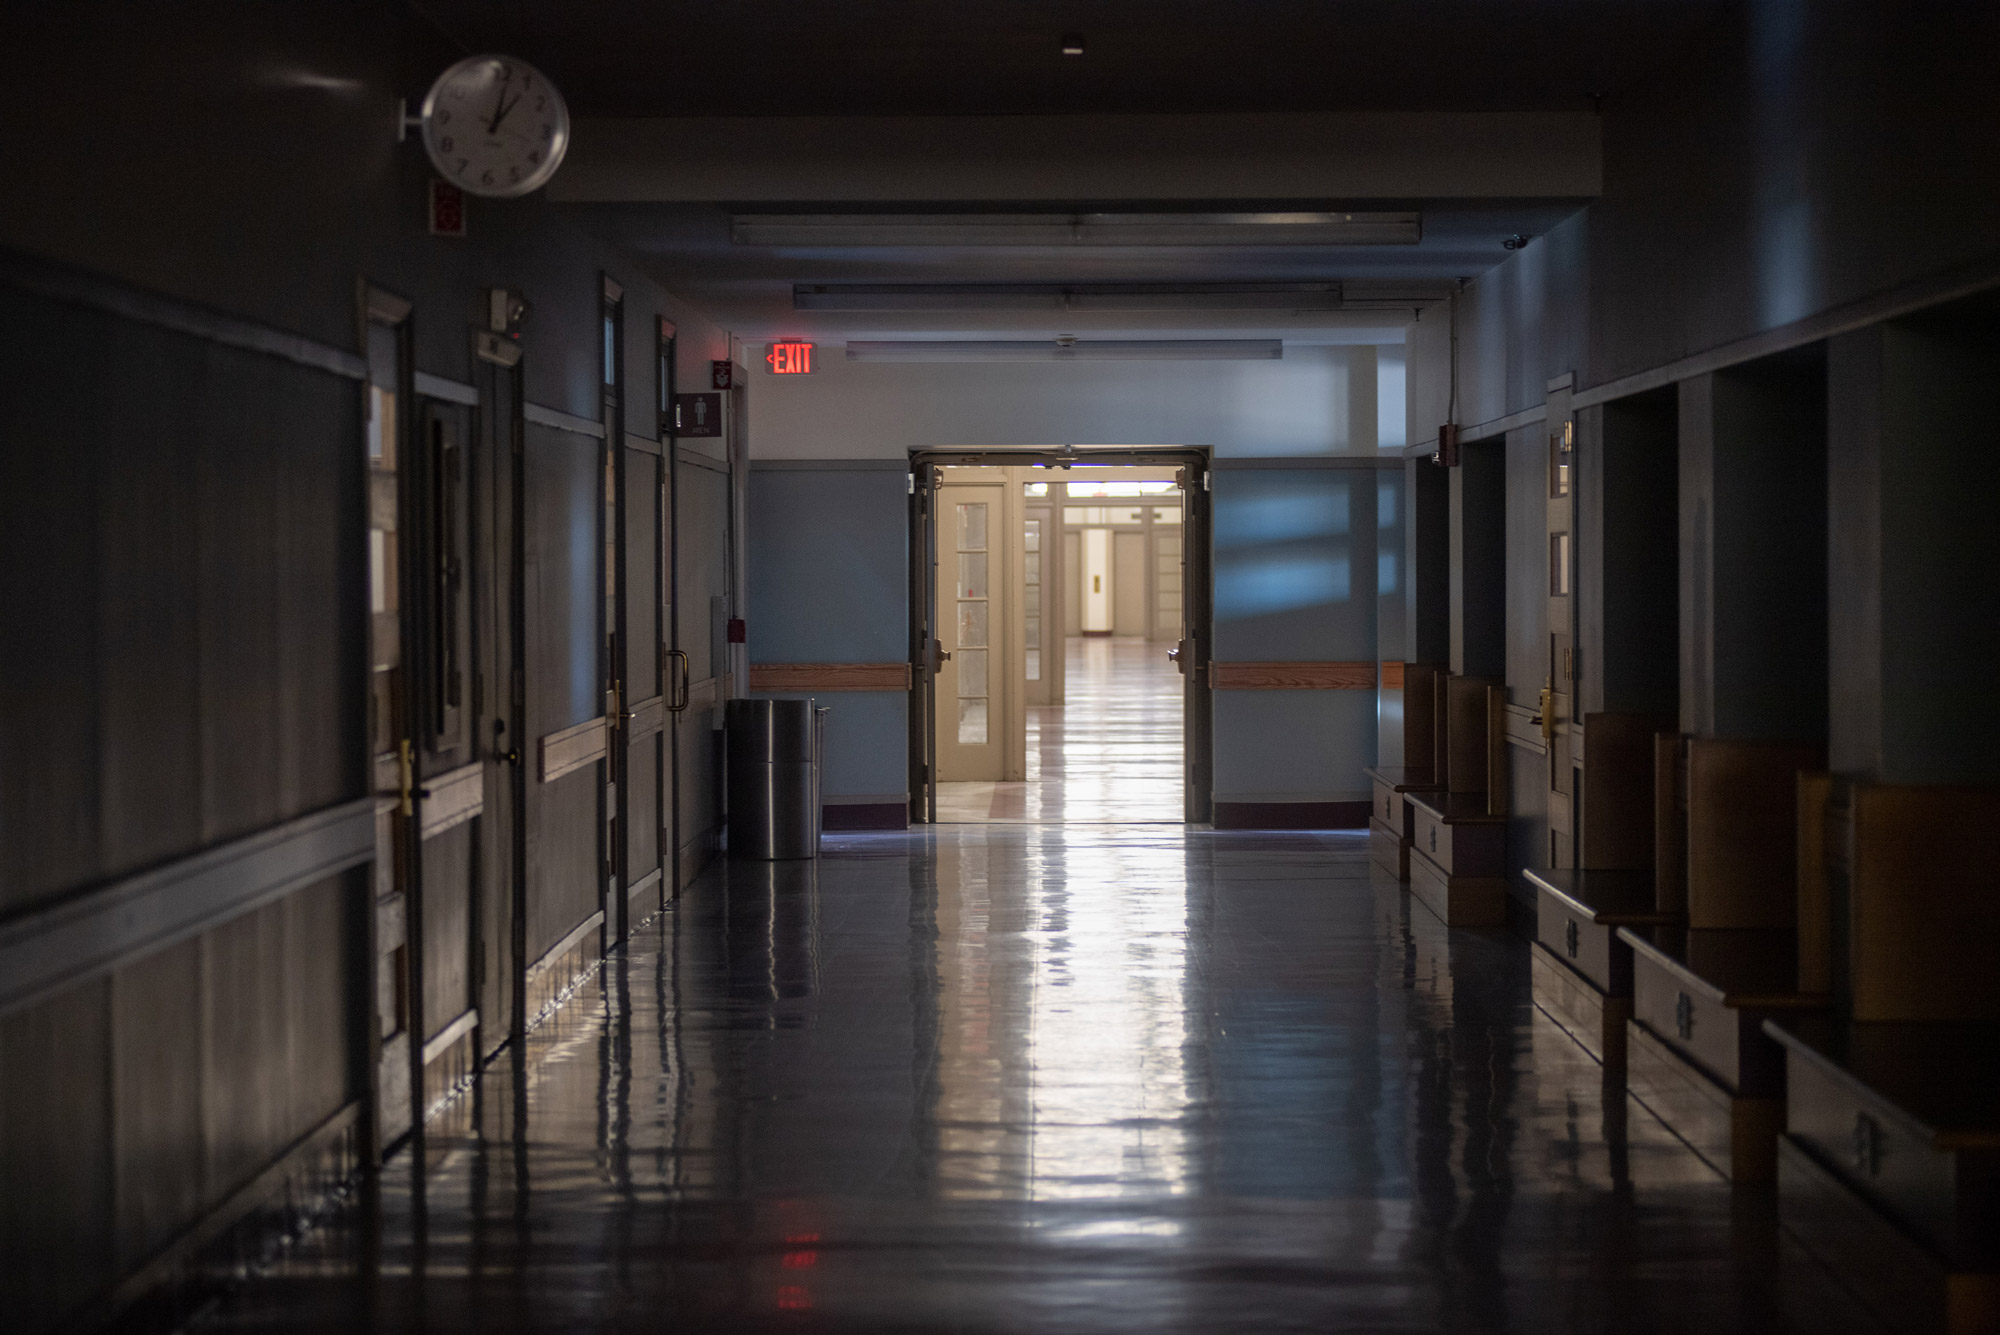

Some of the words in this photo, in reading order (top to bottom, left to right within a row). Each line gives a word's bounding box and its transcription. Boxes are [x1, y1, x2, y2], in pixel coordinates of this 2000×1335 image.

[522, 74, 531, 91] 1
[535, 95, 546, 112] 2
[439, 109, 451, 125] 9
[441, 136, 453, 154] 8
[527, 151, 539, 164] 4
[457, 158, 469, 175] 7
[482, 170, 495, 186] 6
[773, 343, 813, 374] EXIT
